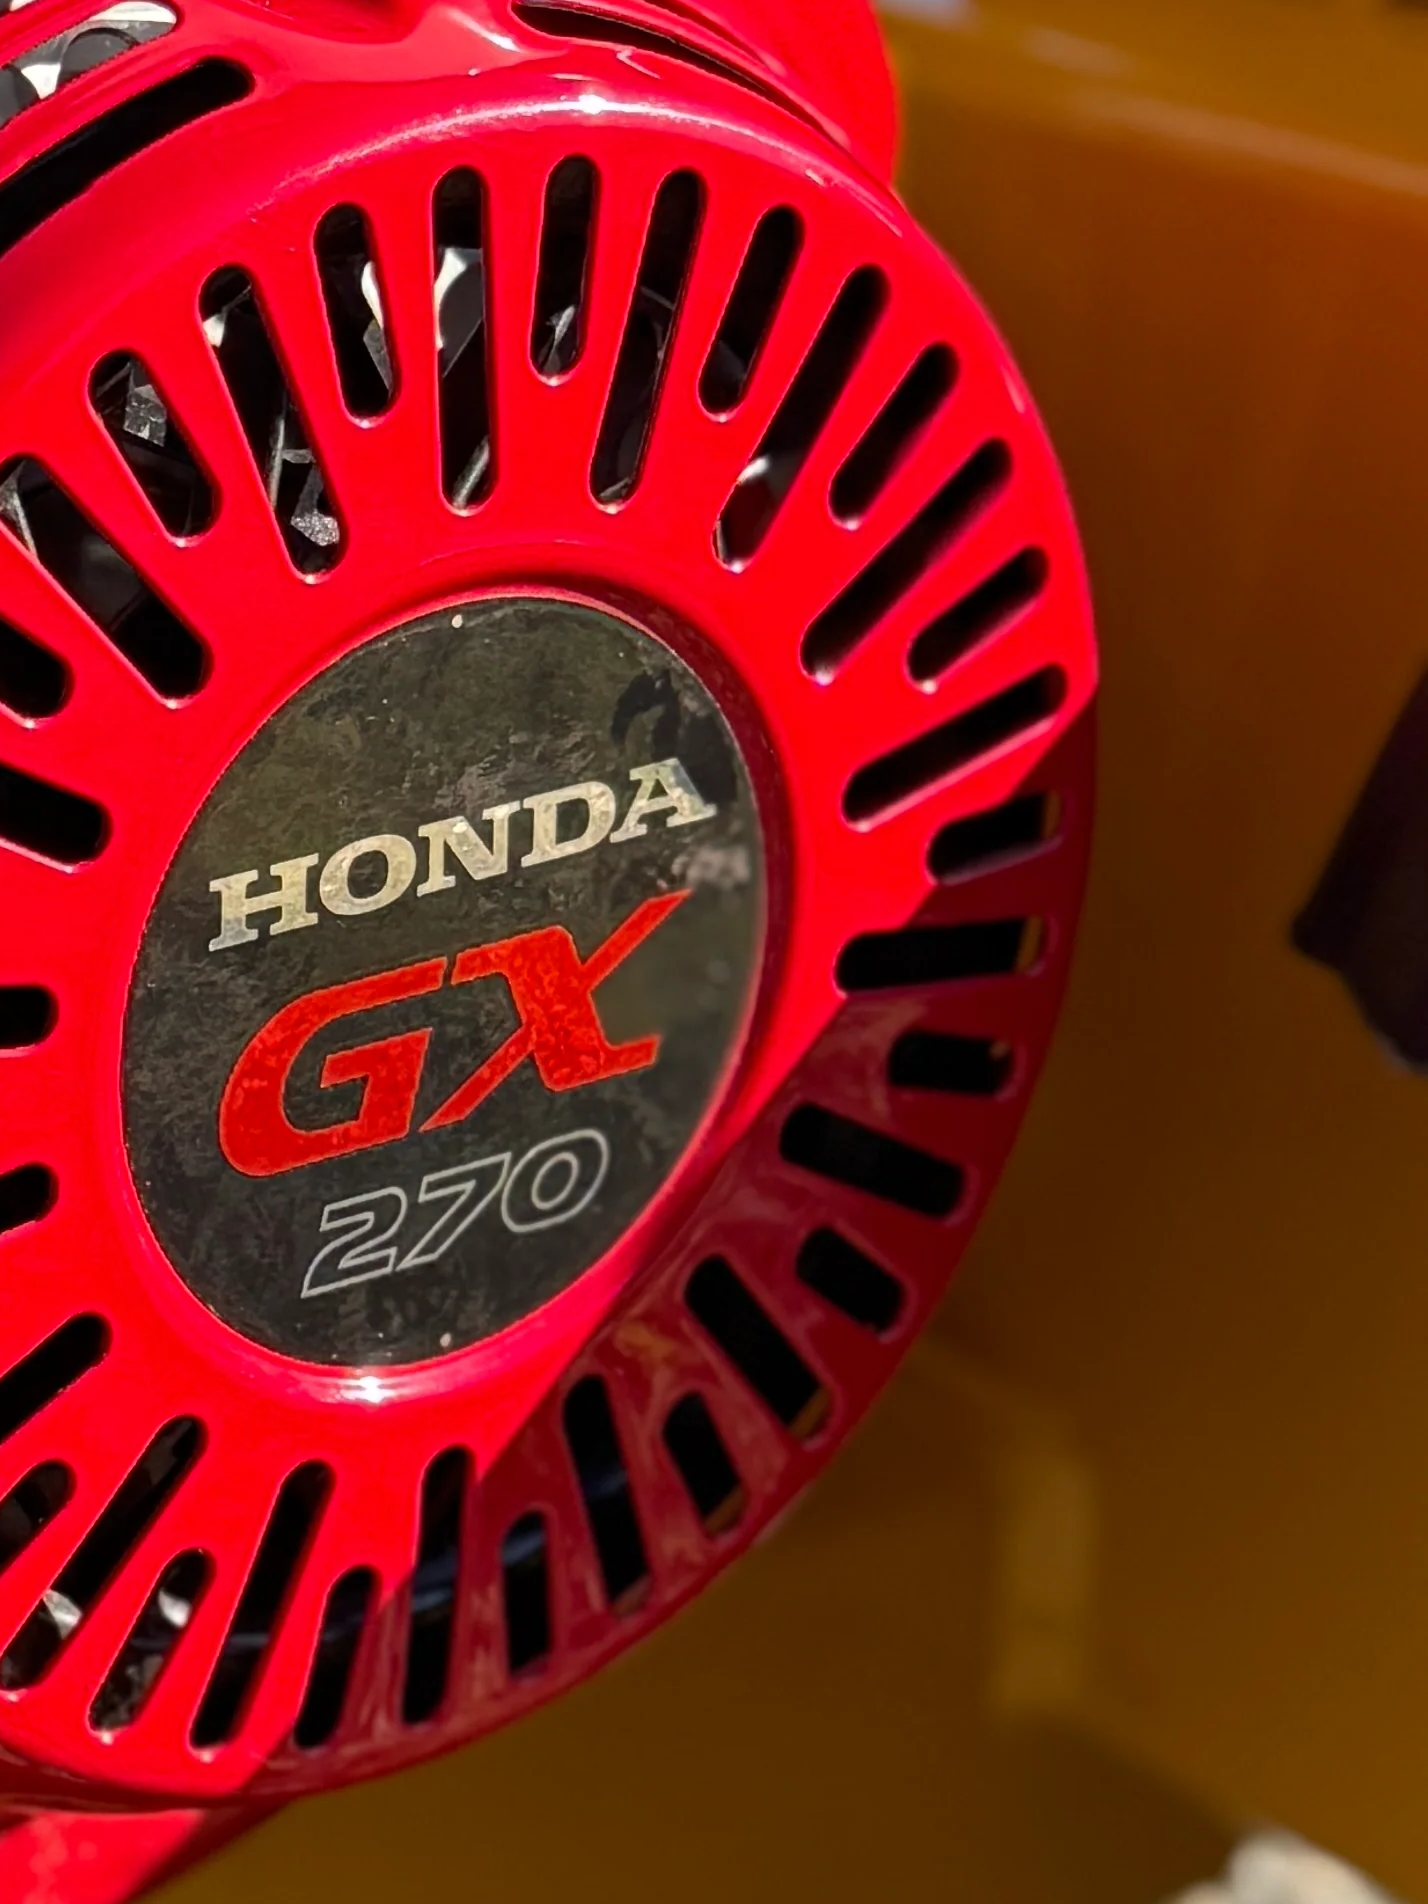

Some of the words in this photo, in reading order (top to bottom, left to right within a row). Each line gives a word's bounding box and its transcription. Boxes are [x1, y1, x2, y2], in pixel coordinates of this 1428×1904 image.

[209, 758, 717, 951] HONDA
[218, 888, 692, 1177] GX
[301, 1128, 610, 1299] 270
